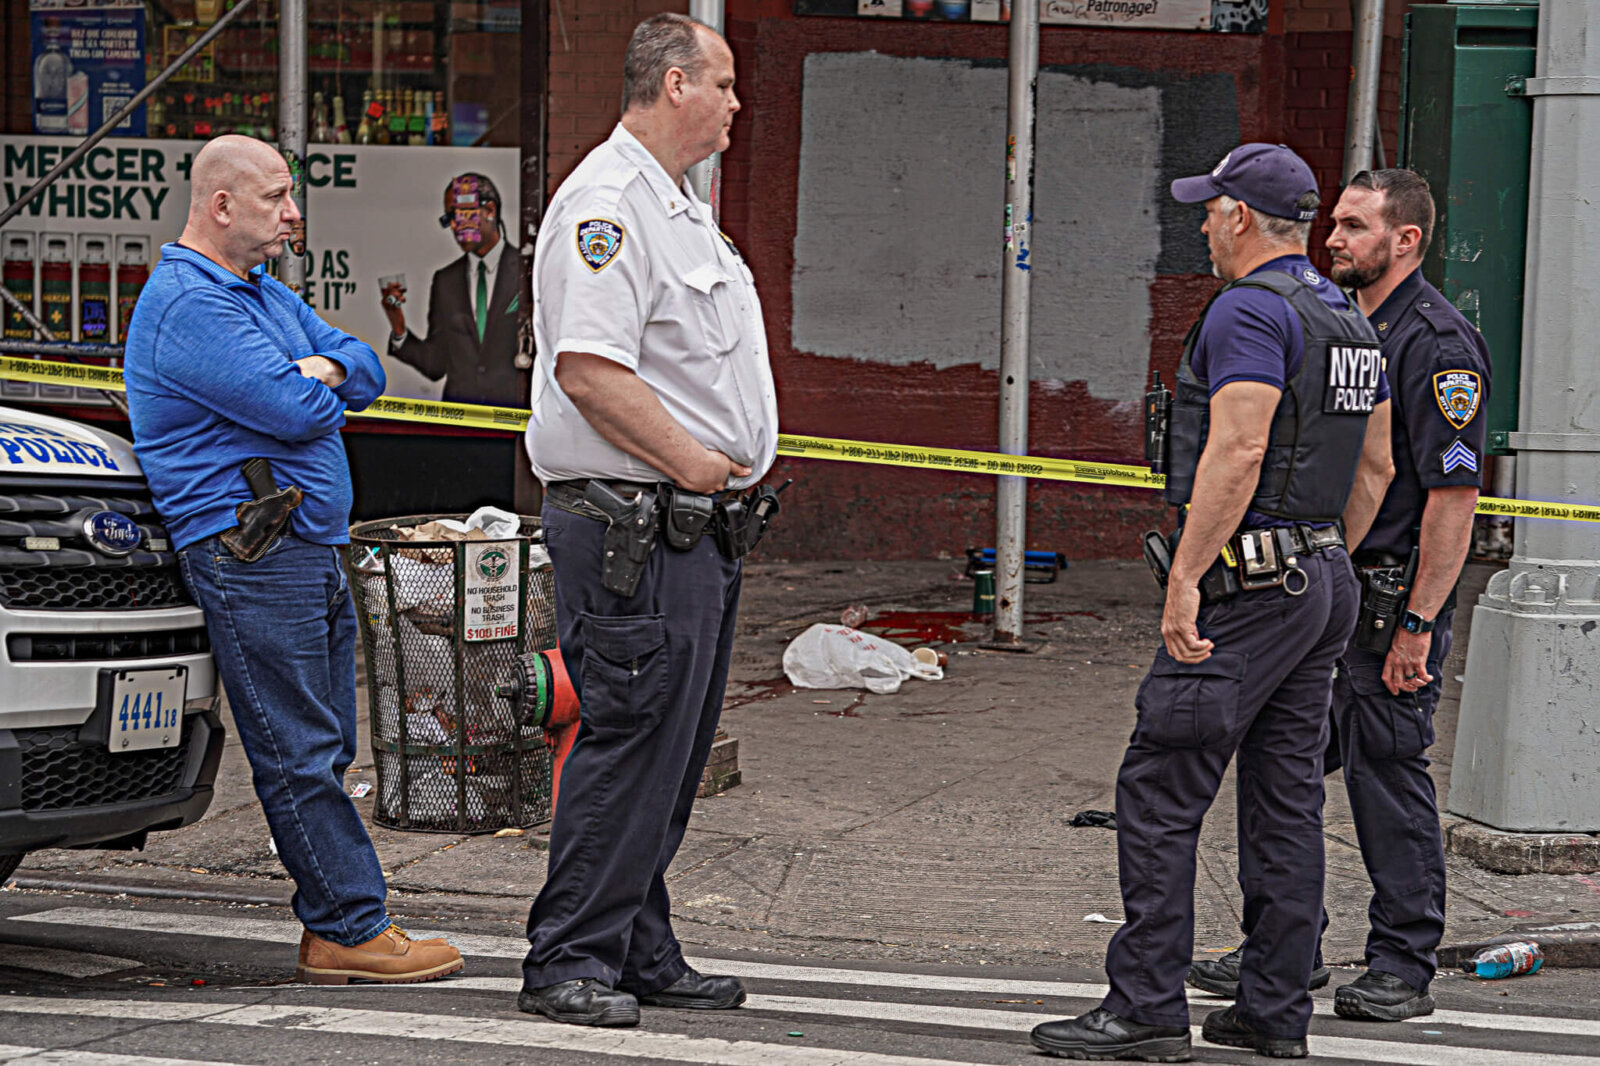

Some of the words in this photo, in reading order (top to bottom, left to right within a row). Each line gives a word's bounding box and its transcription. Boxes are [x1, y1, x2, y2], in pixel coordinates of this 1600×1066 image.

[5, 145, 165, 183] MERCER
[4, 182, 170, 220] WHISKY
[320, 249, 350, 279] AS
[1329, 346, 1381, 388] NYPD
[1334, 388, 1375, 411] POLICE
[1, 436, 120, 472] POLICE
[467, 586, 477, 595] NO
[478, 584, 518, 594] HOUSEHOLD
[482, 594, 505, 602] TRASH
[482, 604, 515, 613] BUSINESS
[482, 613, 505, 621] TRASH
[467, 627, 492, 639] $100
[494, 625, 517, 637] FINE
[119, 691, 162, 731] 4441
[164, 708, 177, 728] 18
